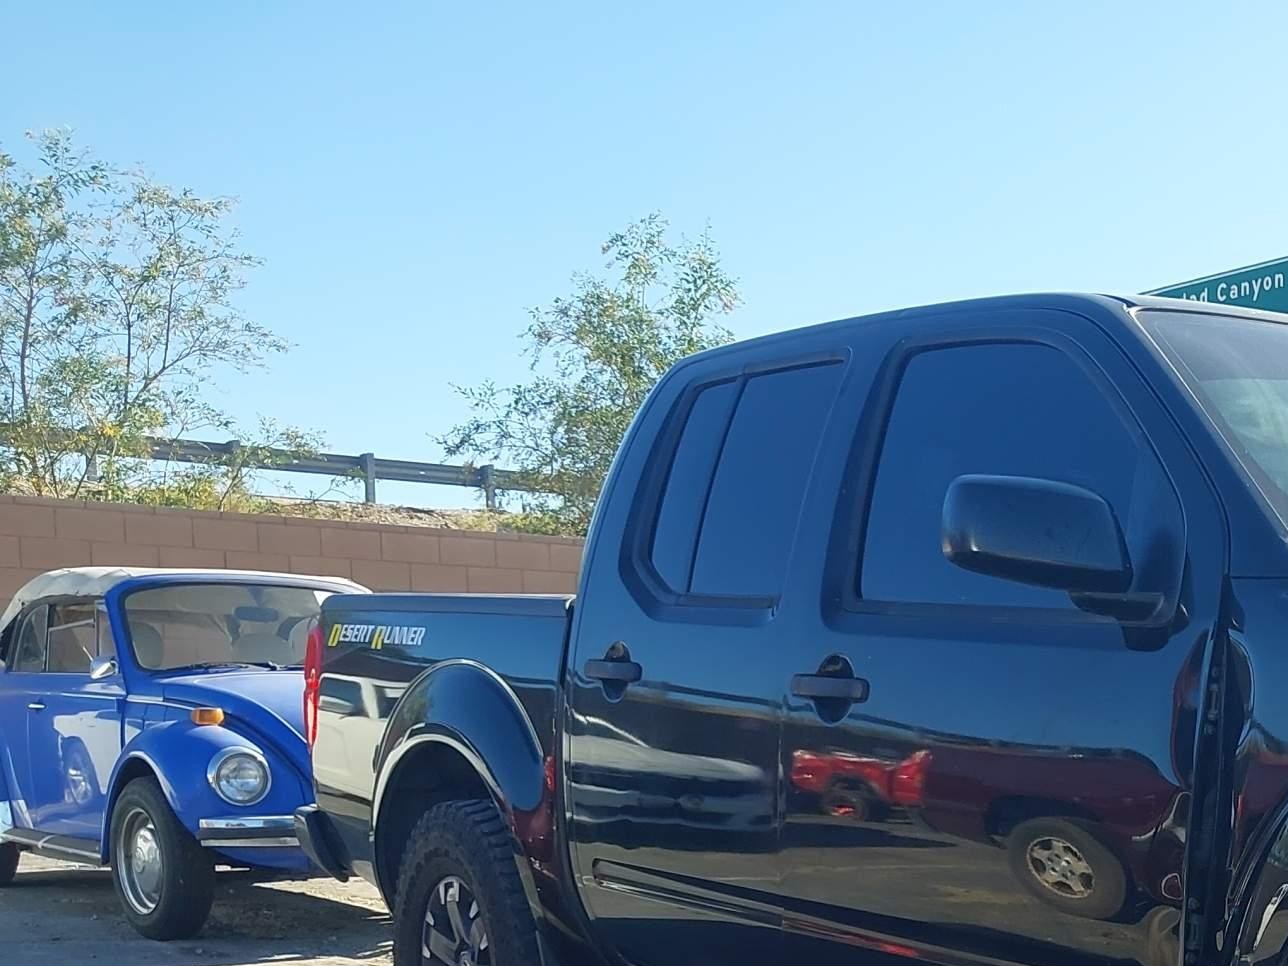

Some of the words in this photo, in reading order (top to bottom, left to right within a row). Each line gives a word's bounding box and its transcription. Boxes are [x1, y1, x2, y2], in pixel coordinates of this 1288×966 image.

[1217, 273, 1284, 302] Canyon
[328, 623, 376, 647] DESERT
[371, 625, 426, 650] RUNNER
